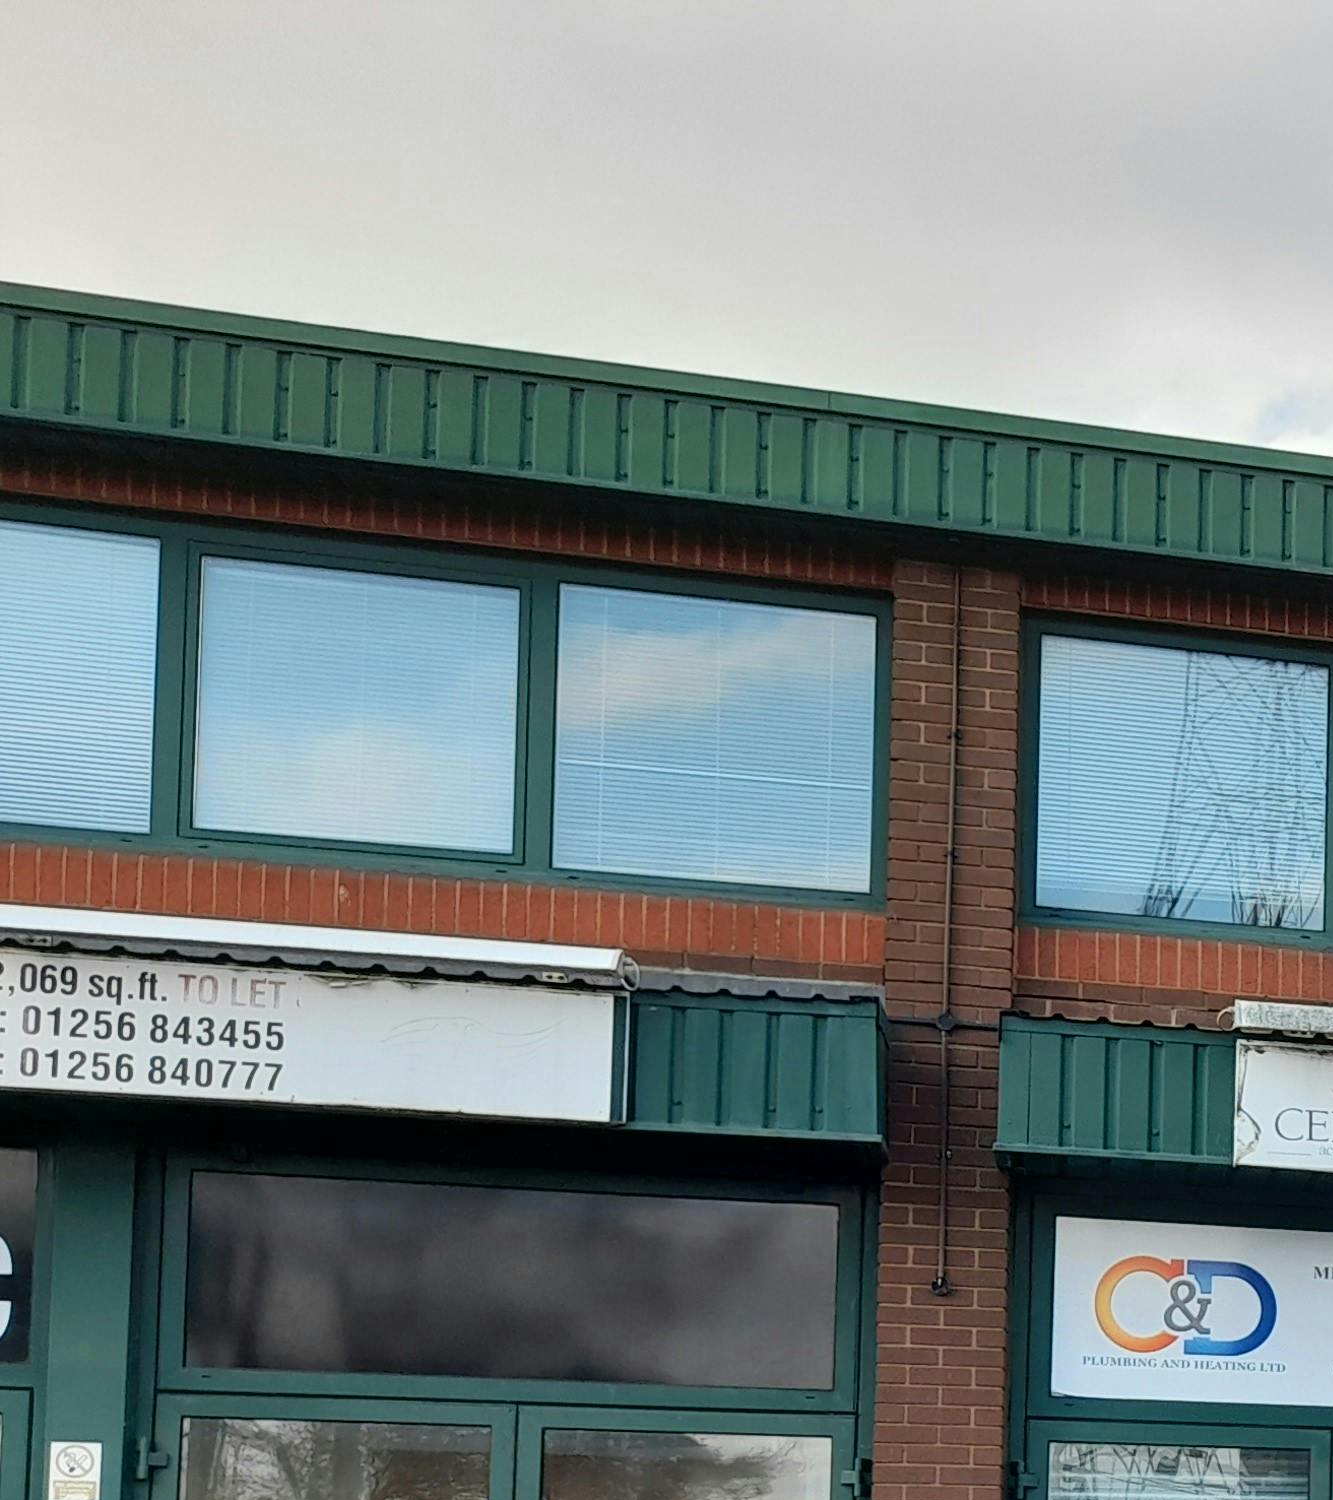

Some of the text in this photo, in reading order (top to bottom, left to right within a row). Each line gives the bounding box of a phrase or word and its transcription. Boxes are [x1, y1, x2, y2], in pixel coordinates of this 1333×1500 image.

[0, 962, 78, 997] ,069
[178, 973, 218, 1004] TO
[231, 977, 286, 1008] LET
[22, 1005, 136, 1041] 01256
[150, 1014, 284, 1051] 843455
[20, 1047, 134, 1083] 01256
[148, 1055, 284, 1092] 840777
[1083, 1355, 1286, 1373] PLUMBING AND HEATING LTD
